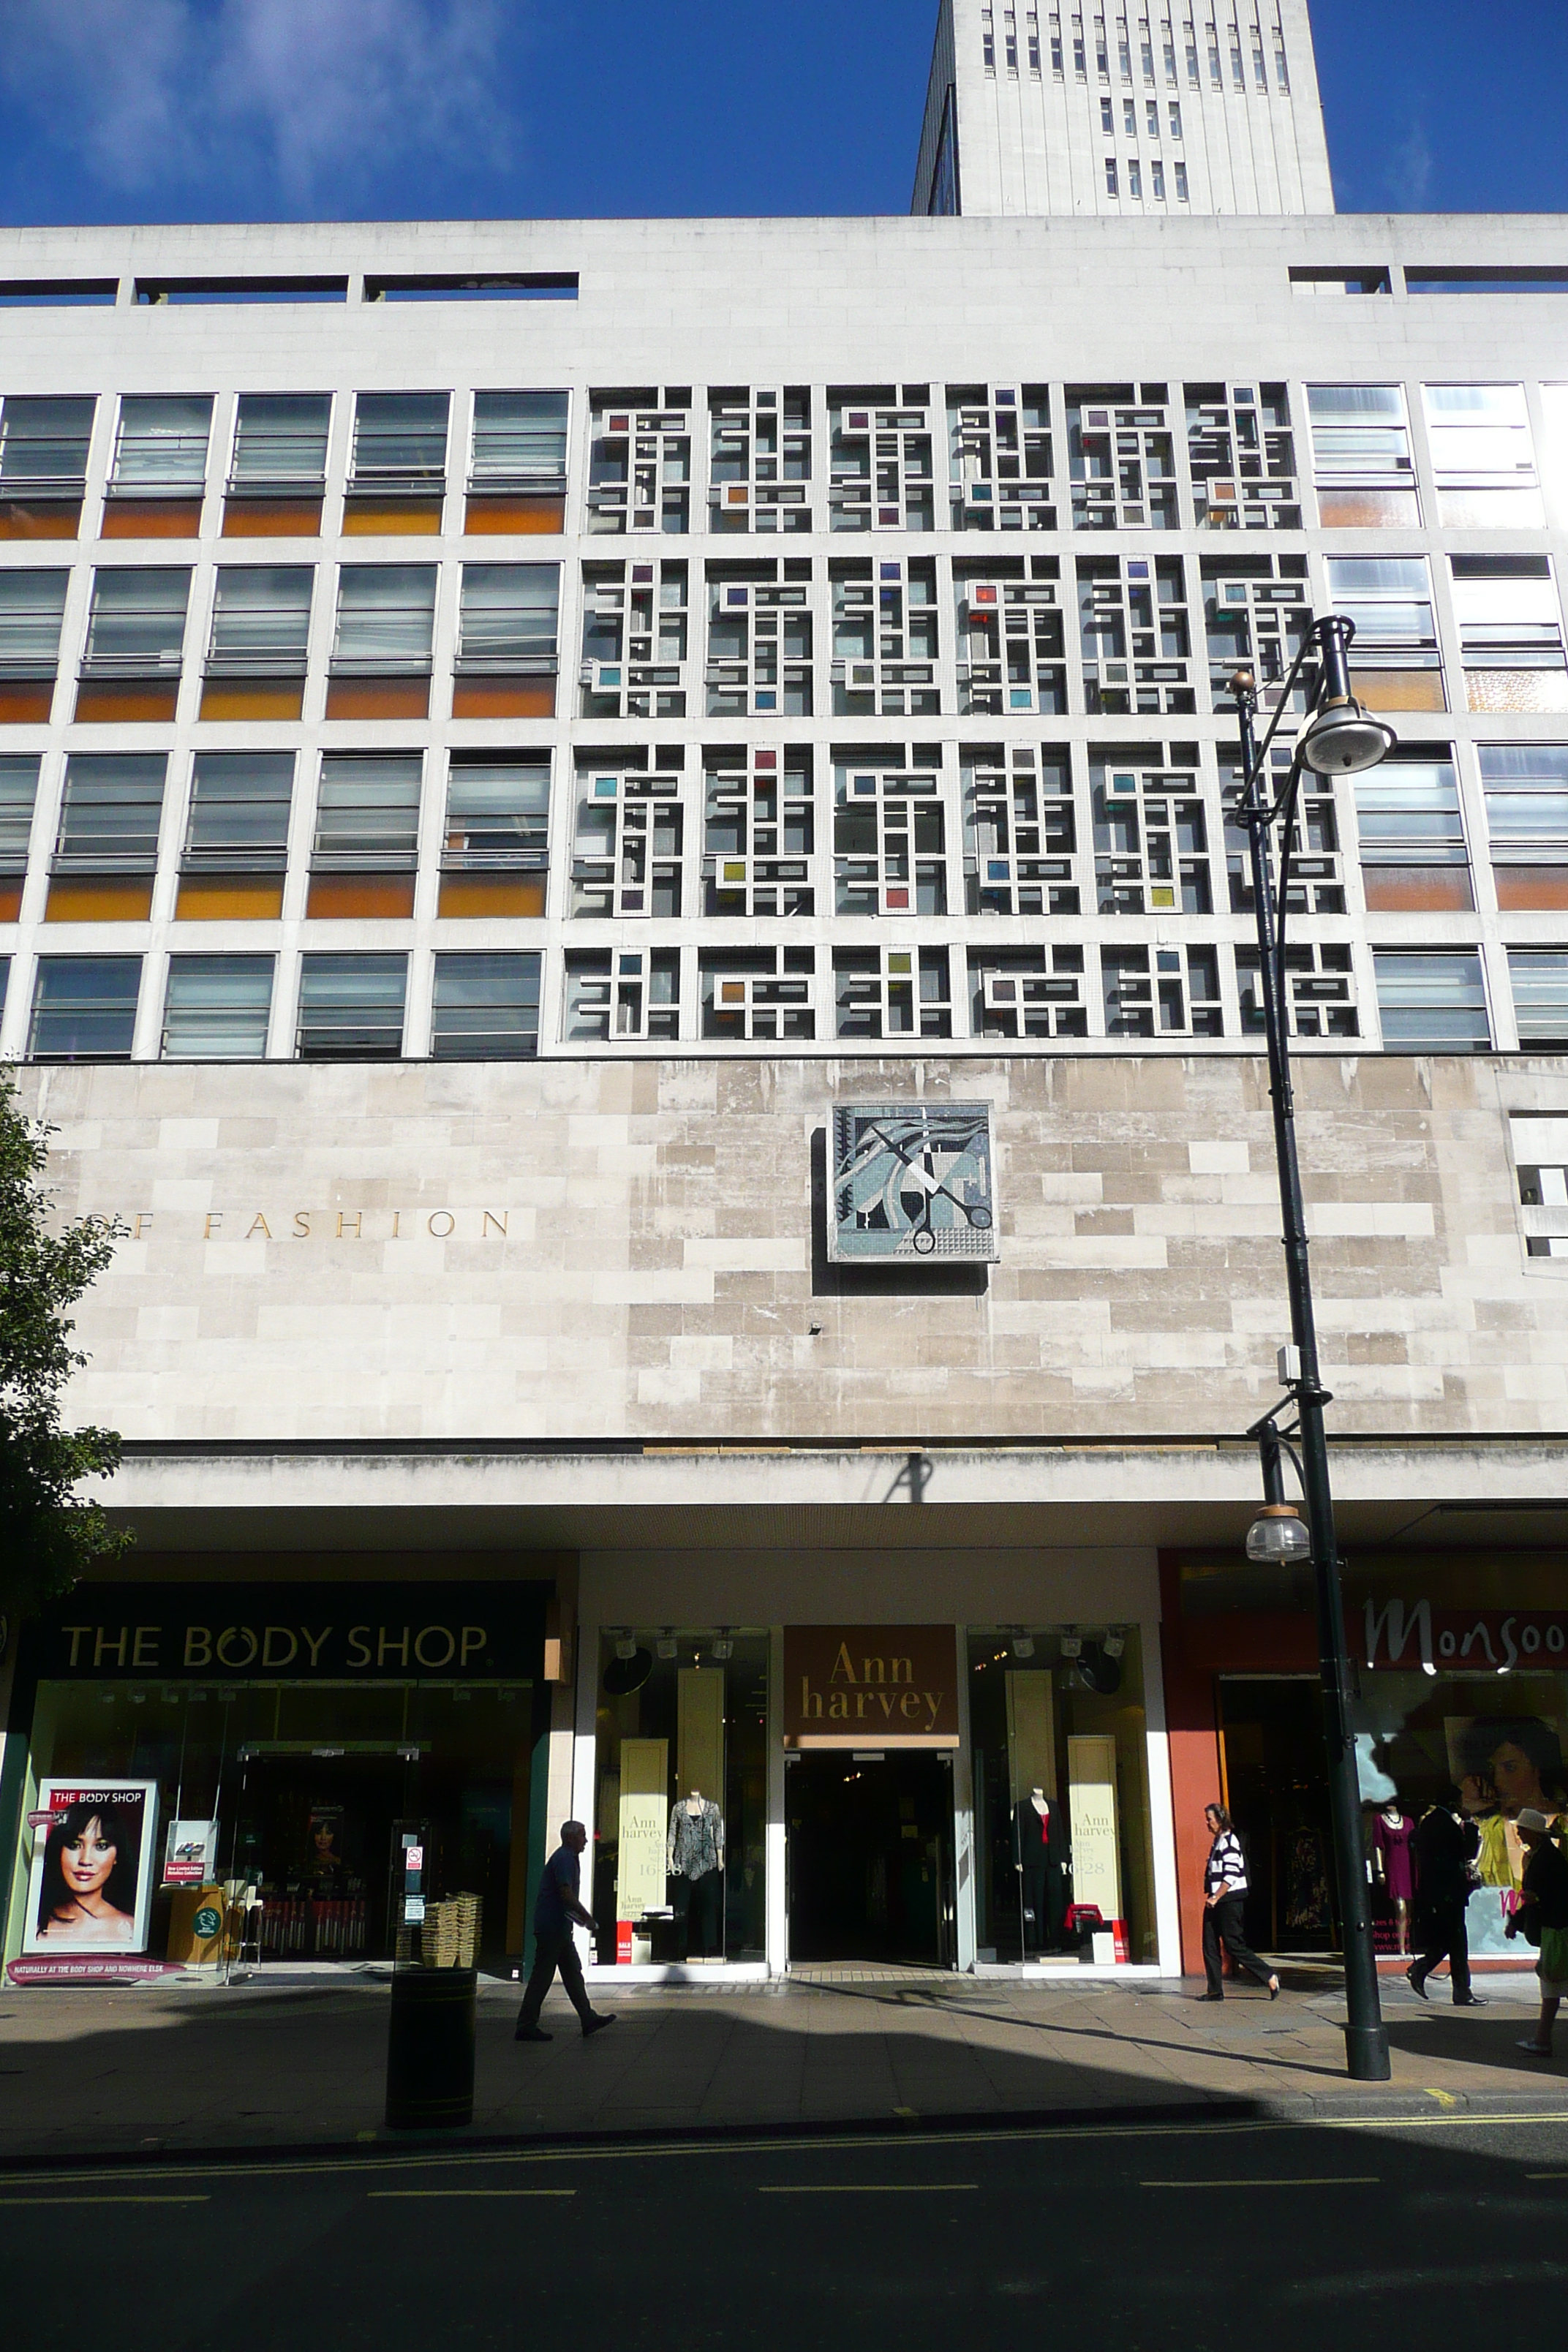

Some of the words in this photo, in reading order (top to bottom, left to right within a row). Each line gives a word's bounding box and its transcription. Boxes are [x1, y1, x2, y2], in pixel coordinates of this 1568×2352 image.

[203, 1210, 510, 1240] FASHION
[61, 1626, 162, 1667] THE
[183, 1625, 333, 1668] BODY
[345, 1625, 488, 1668] SHOP
[826, 1641, 915, 1684] Ann
[799, 1675, 945, 1732] harvey
[54, 1793, 76, 1803] THE
[79, 1793, 110, 1803] BODY
[111, 1793, 142, 1803] SHOP
[629, 1815, 657, 1828] Ann
[1082, 1813, 1109, 1826] Ann
[622, 1825, 664, 1842] harvey
[1074, 1823, 1115, 1840] harvey
[639, 1863, 682, 1877] 16-28
[15, 1966, 48, 1974] NATURALLY
[70, 1965, 86, 1973] BODY
[87, 1965, 104, 1973] SHOP
